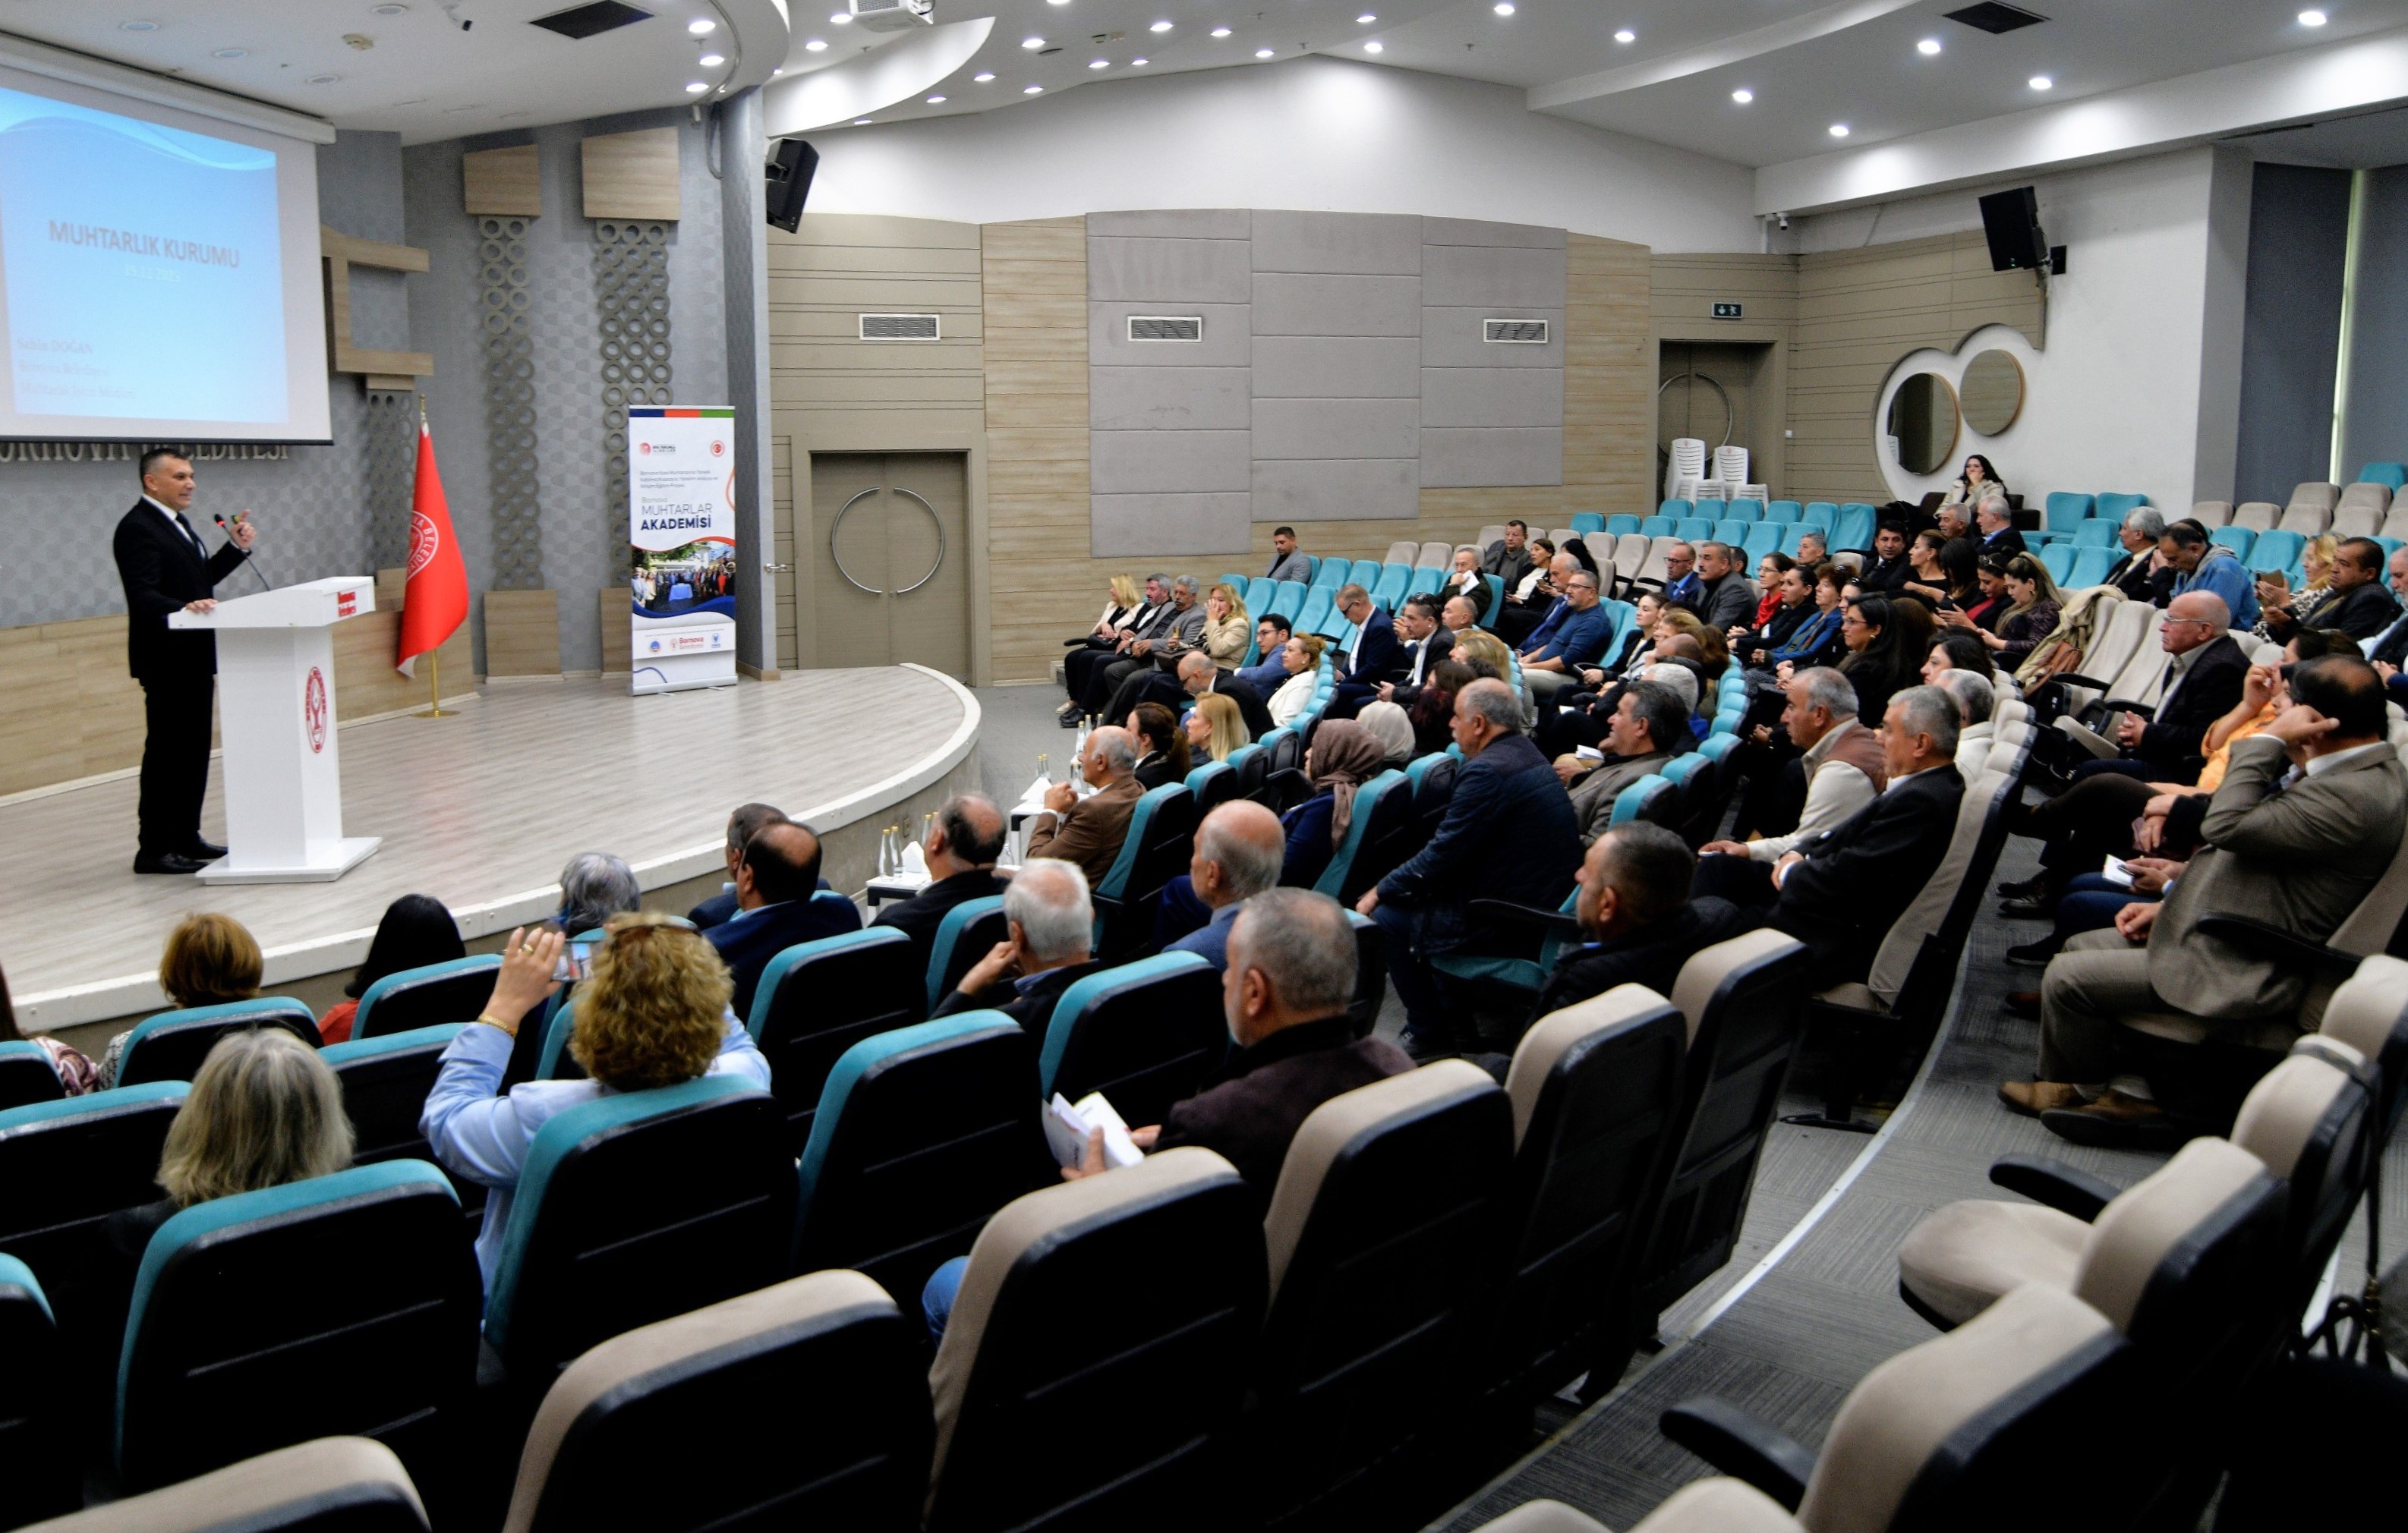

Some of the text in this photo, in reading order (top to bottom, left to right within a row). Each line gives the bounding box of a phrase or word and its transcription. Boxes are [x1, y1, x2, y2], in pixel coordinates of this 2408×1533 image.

[49, 220, 239, 268] MUHTARLIK KURUMU
[641, 504, 712, 515] MUHTARLAR
[641, 515, 711, 530] AKADEMİSİ
